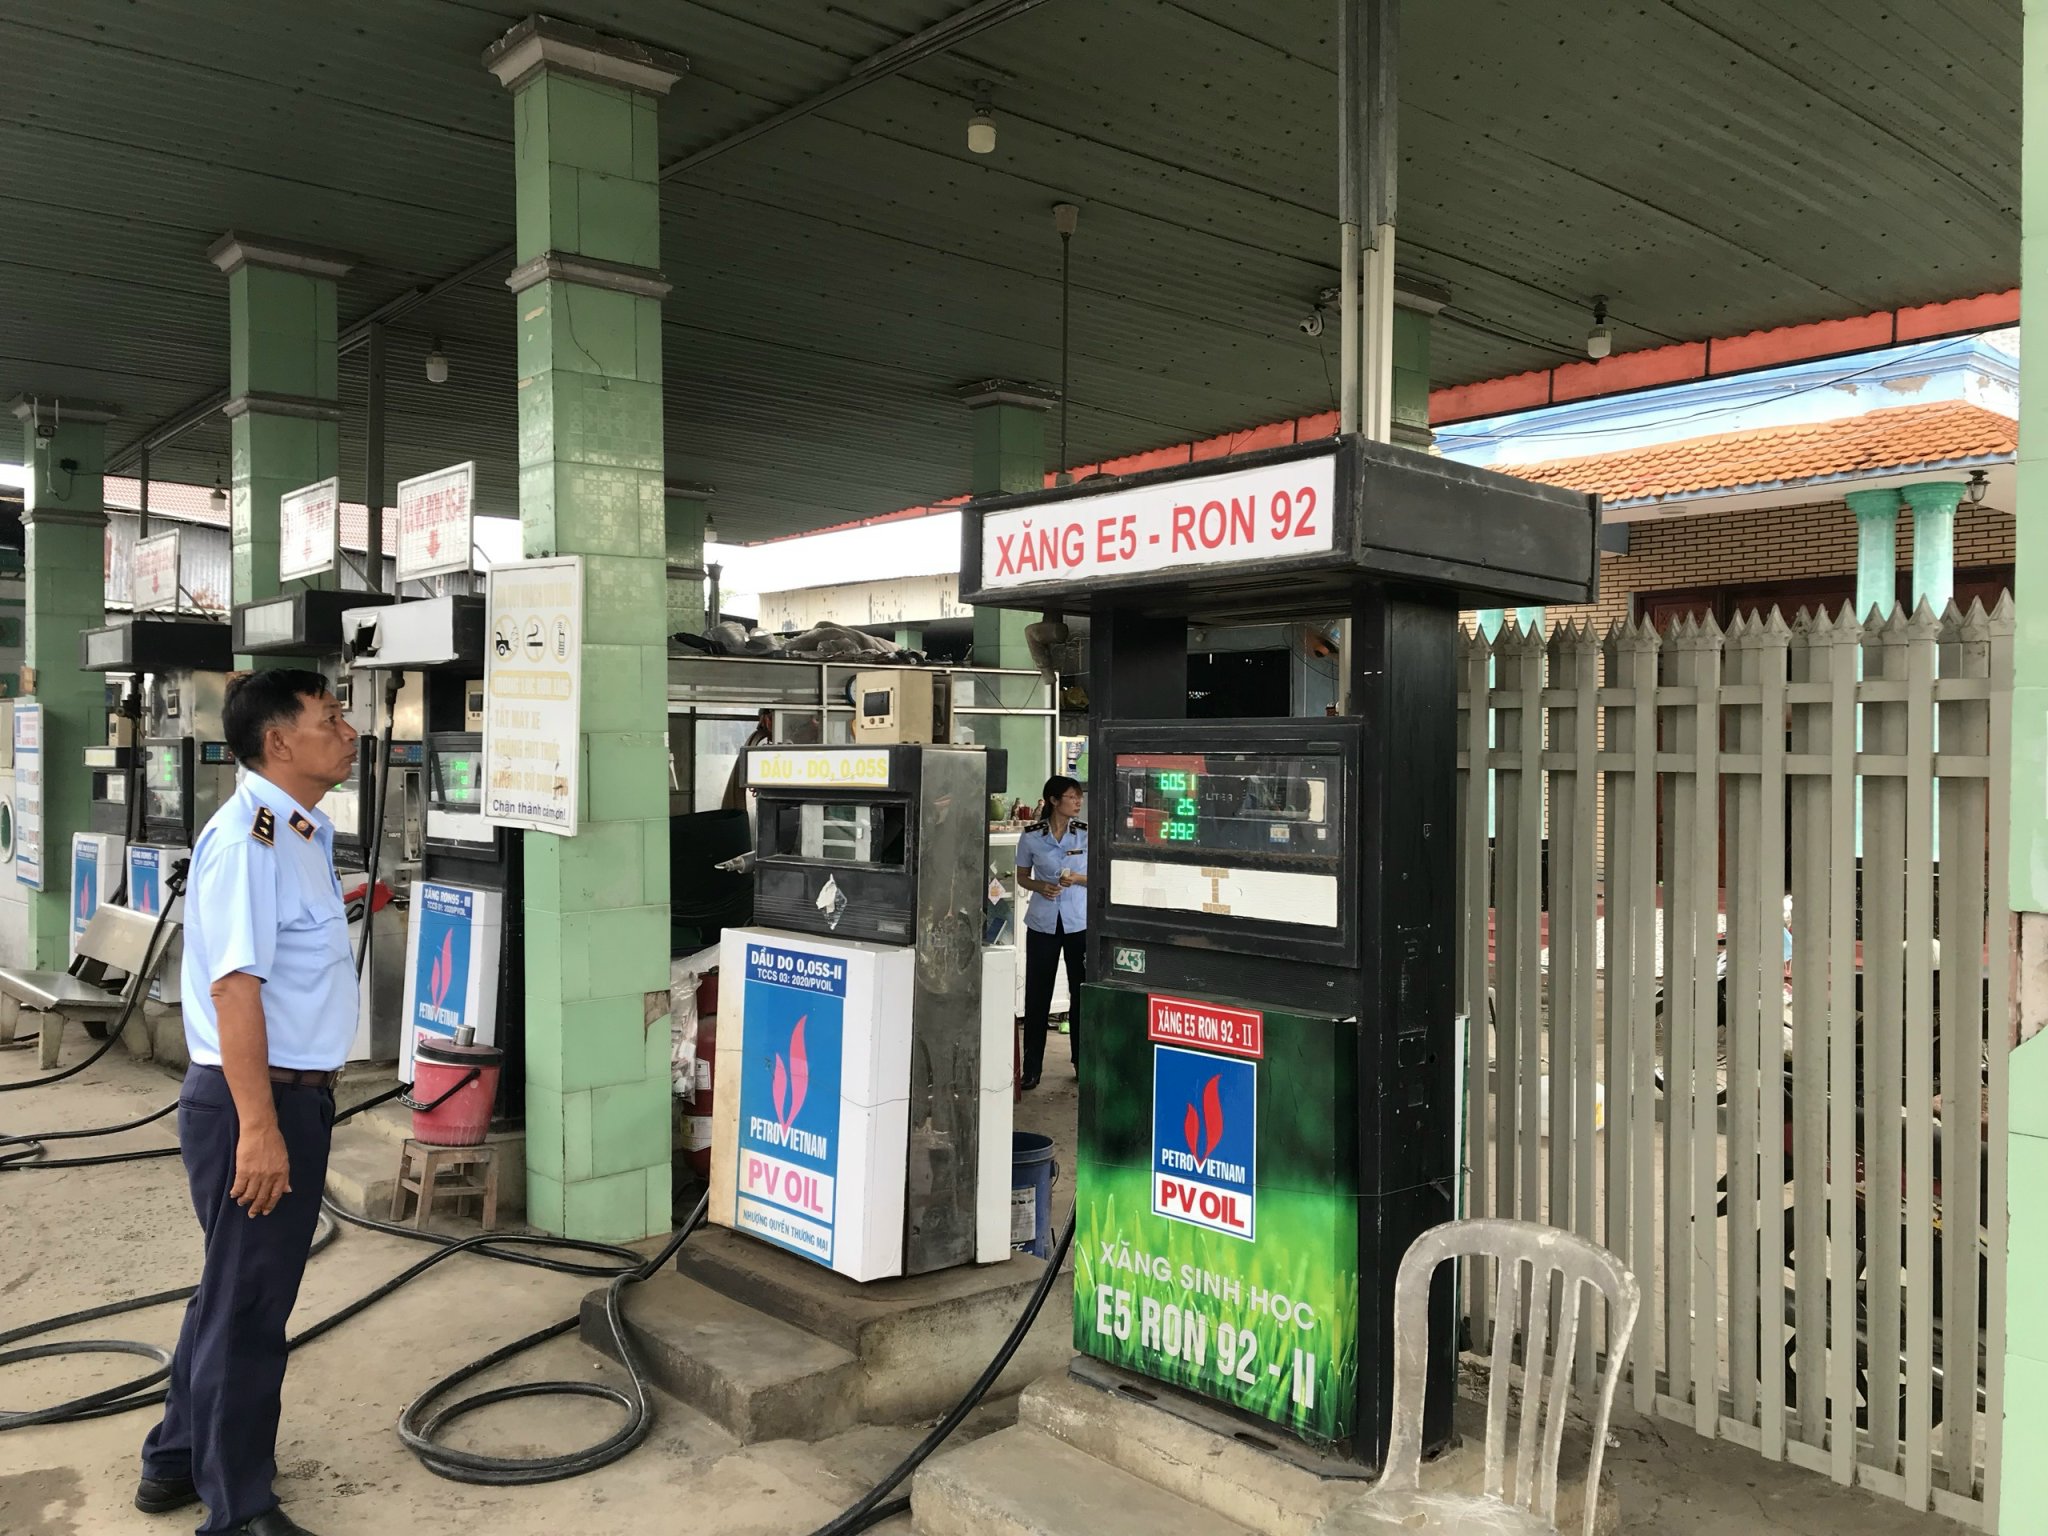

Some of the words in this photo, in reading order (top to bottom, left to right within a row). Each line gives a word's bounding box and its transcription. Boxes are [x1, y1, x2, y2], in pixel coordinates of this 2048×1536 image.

[995, 519, 1085, 577] XĂNG
[1097, 514, 1137, 563] E5
[1149, 534, 1160, 545] -
[1171, 495, 1256, 553] RON
[1270, 486, 1317, 541] 92
[1160, 773, 1196, 791] 6051
[492, 799, 516, 813] Chân
[518, 801, 541, 817] thành
[1160, 821, 1195, 840] 2392
[757, 968, 778, 981] TCCS
[778, 972, 791, 984] 03:
[791, 974, 834, 992] 2020/PVOIL
[777, 954, 794, 972] DO
[796, 958, 842, 980] 0,05S-II
[1158, 1005, 1182, 1035] XĂNG
[1184, 1013, 1196, 1038] E5
[1198, 1015, 1218, 1041] RON
[1221, 1019, 1234, 1044] 92
[1242, 1023, 1253, 1047] II
[750, 1116, 827, 1161] PETROVIETNAM
[748, 1158, 780, 1196] PV
[784, 1170, 824, 1214] OIL
[1161, 1148, 1246, 1184] PETROVIETNAM
[1161, 1179, 1197, 1213] PV
[1199, 1191, 1245, 1229] OIL
[1100, 1240, 1171, 1282] XĂNG
[1180, 1264, 1240, 1305] SINH
[1250, 1285, 1315, 1331] HỌC
[1096, 1283, 1131, 1341] E5
[1141, 1295, 1206, 1367] RON
[1217, 1322, 1258, 1385] 92
[1268, 1363, 1281, 1377] -
[1292, 1348, 1315, 1410] II
